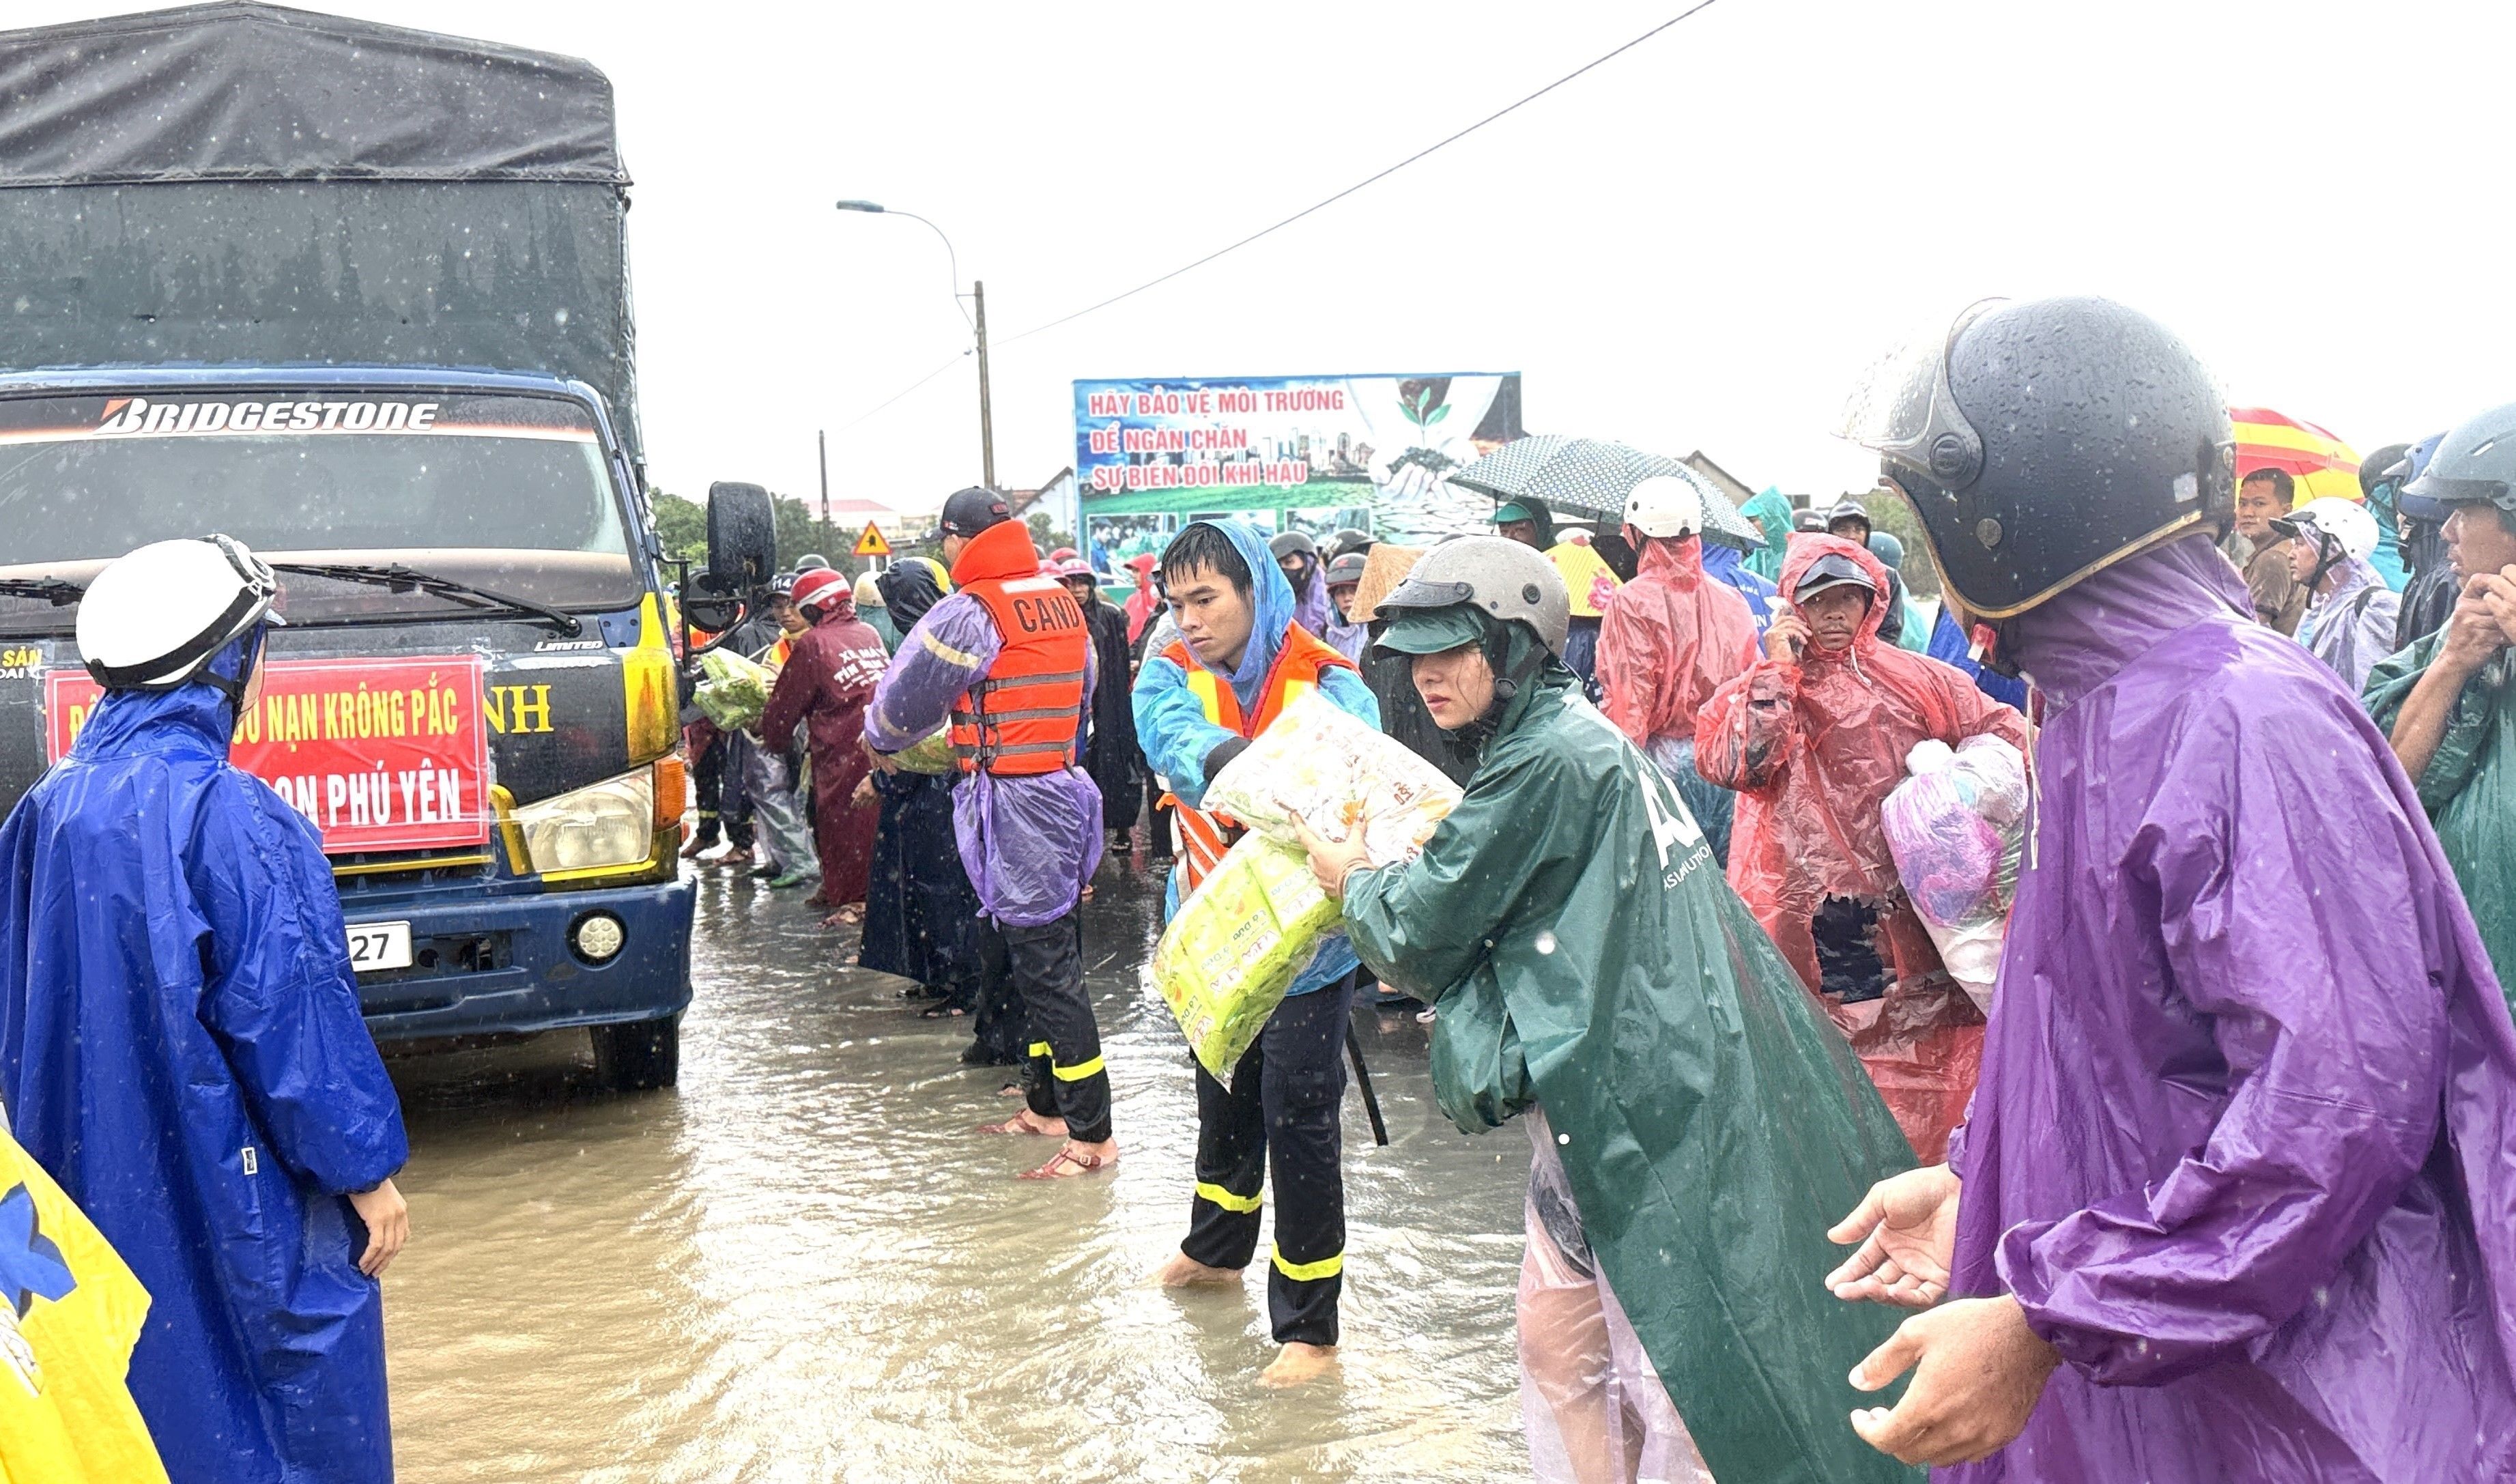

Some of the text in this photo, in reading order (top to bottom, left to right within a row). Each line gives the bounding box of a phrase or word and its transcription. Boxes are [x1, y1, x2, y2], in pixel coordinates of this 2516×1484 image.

[93, 397, 440, 436] BRIDGESTONE
[1091, 386, 1343, 418] HÃY BẢO VỆ MÔI TRƯỜNG
[1092, 423, 1246, 453] ĐỂ NGĂN CHẶN
[1093, 465, 1122, 491] SỰ
[1225, 460, 1259, 485] KHÍ
[1266, 459, 1305, 487] HẬU
[772, 578, 792, 590] 114
[1013, 595, 1080, 633] CAND
[2, 646, 43, 668] SẢN
[534, 640, 603, 653] LIMITED
[267, 693, 319, 752] NẠN
[324, 681, 406, 740] KRÔNG
[410, 672, 459, 737] PẮC
[258, 757, 461, 827] ON PHÚ YÊN
